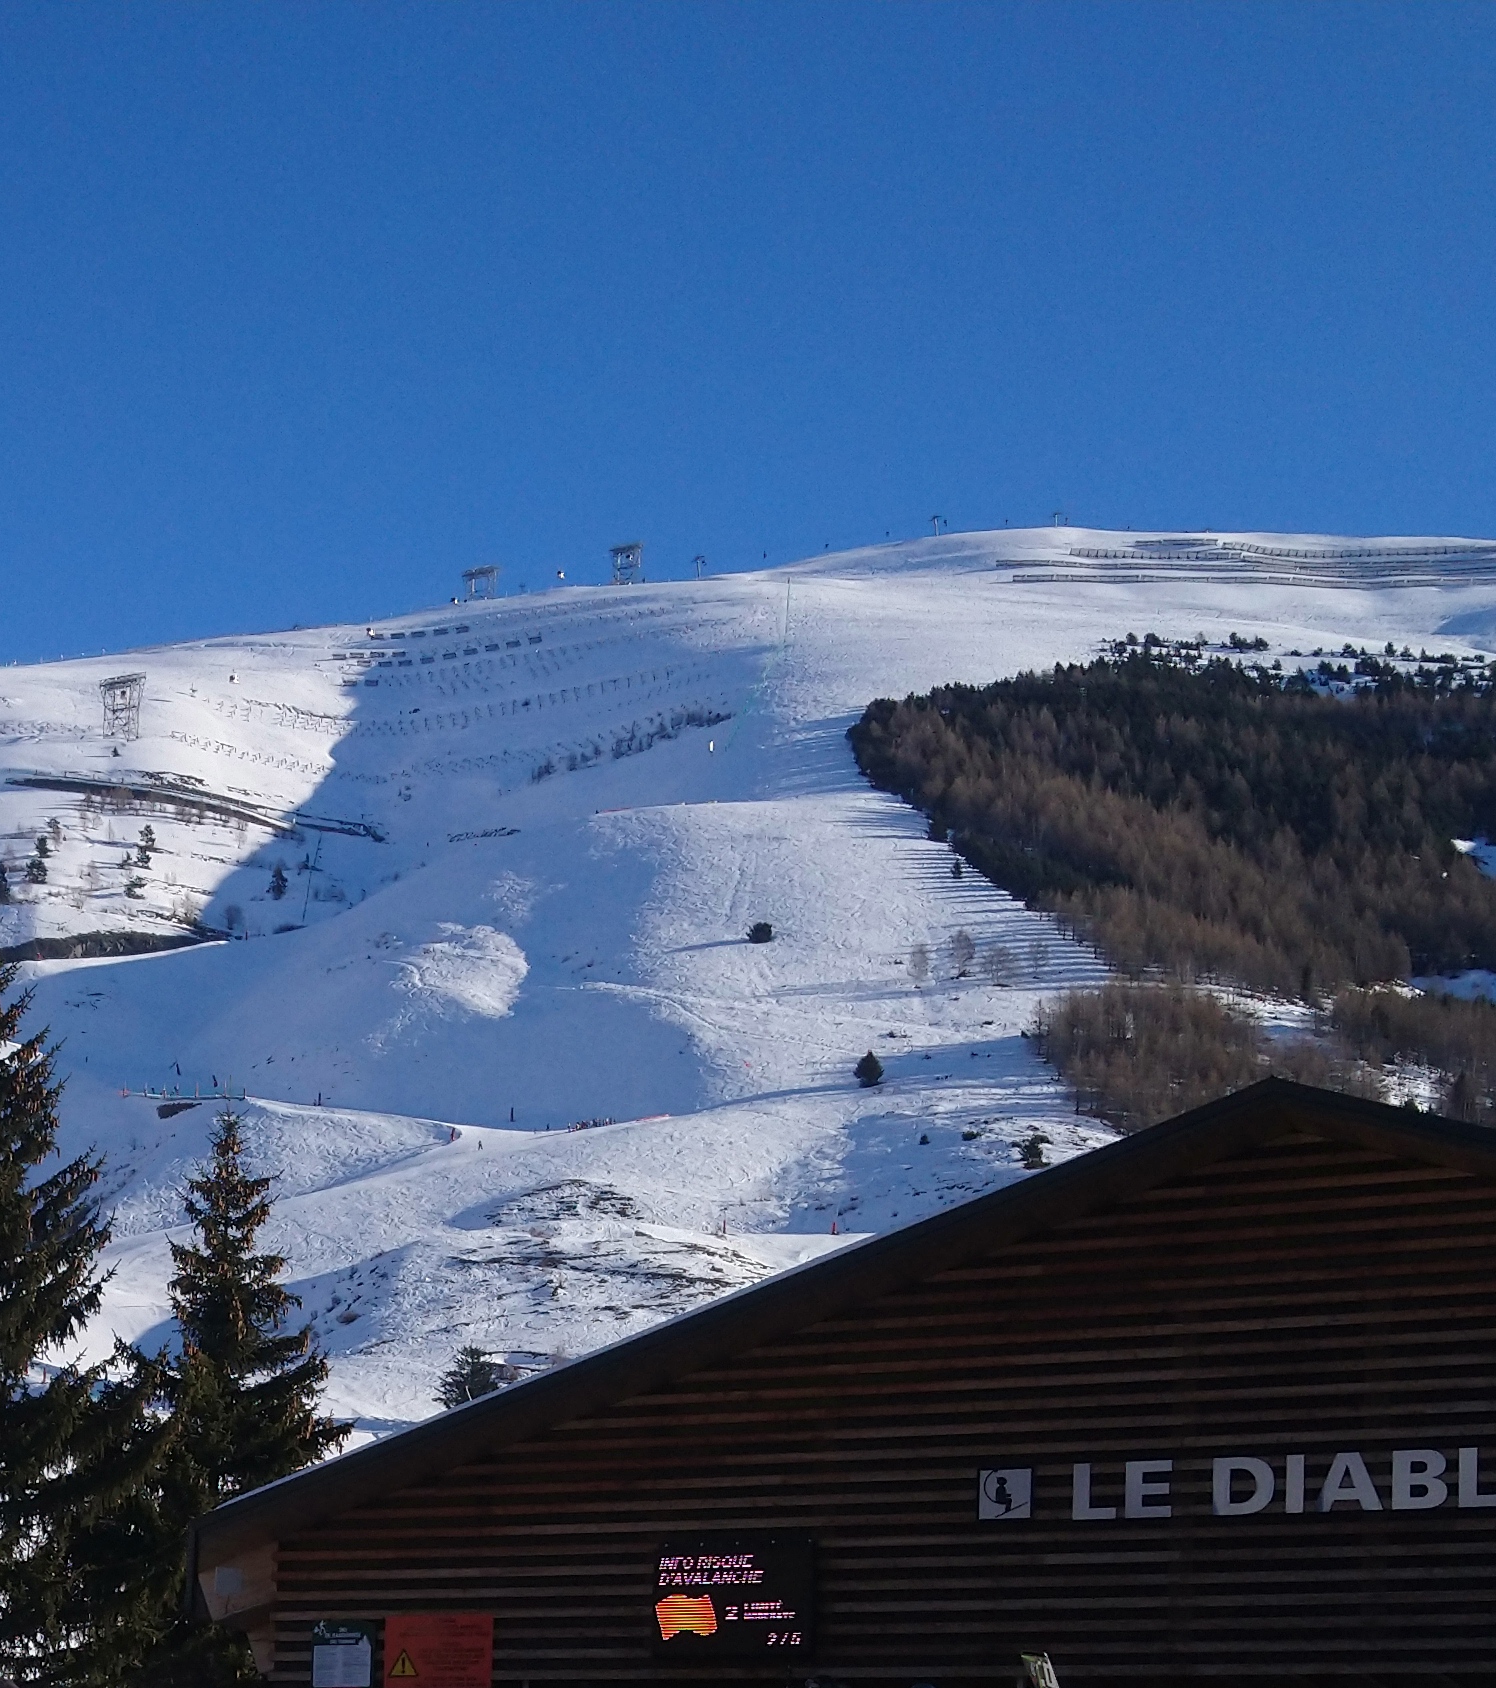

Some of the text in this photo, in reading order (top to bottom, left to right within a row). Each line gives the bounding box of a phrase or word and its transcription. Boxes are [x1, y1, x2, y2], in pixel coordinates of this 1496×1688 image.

[1071, 1459, 1174, 1520] LE
[658, 1554, 755, 1570] INFO RISQUE
[658, 1570, 765, 1586] D'AVALANCHE
[724, 1605, 739, 1621] 2
